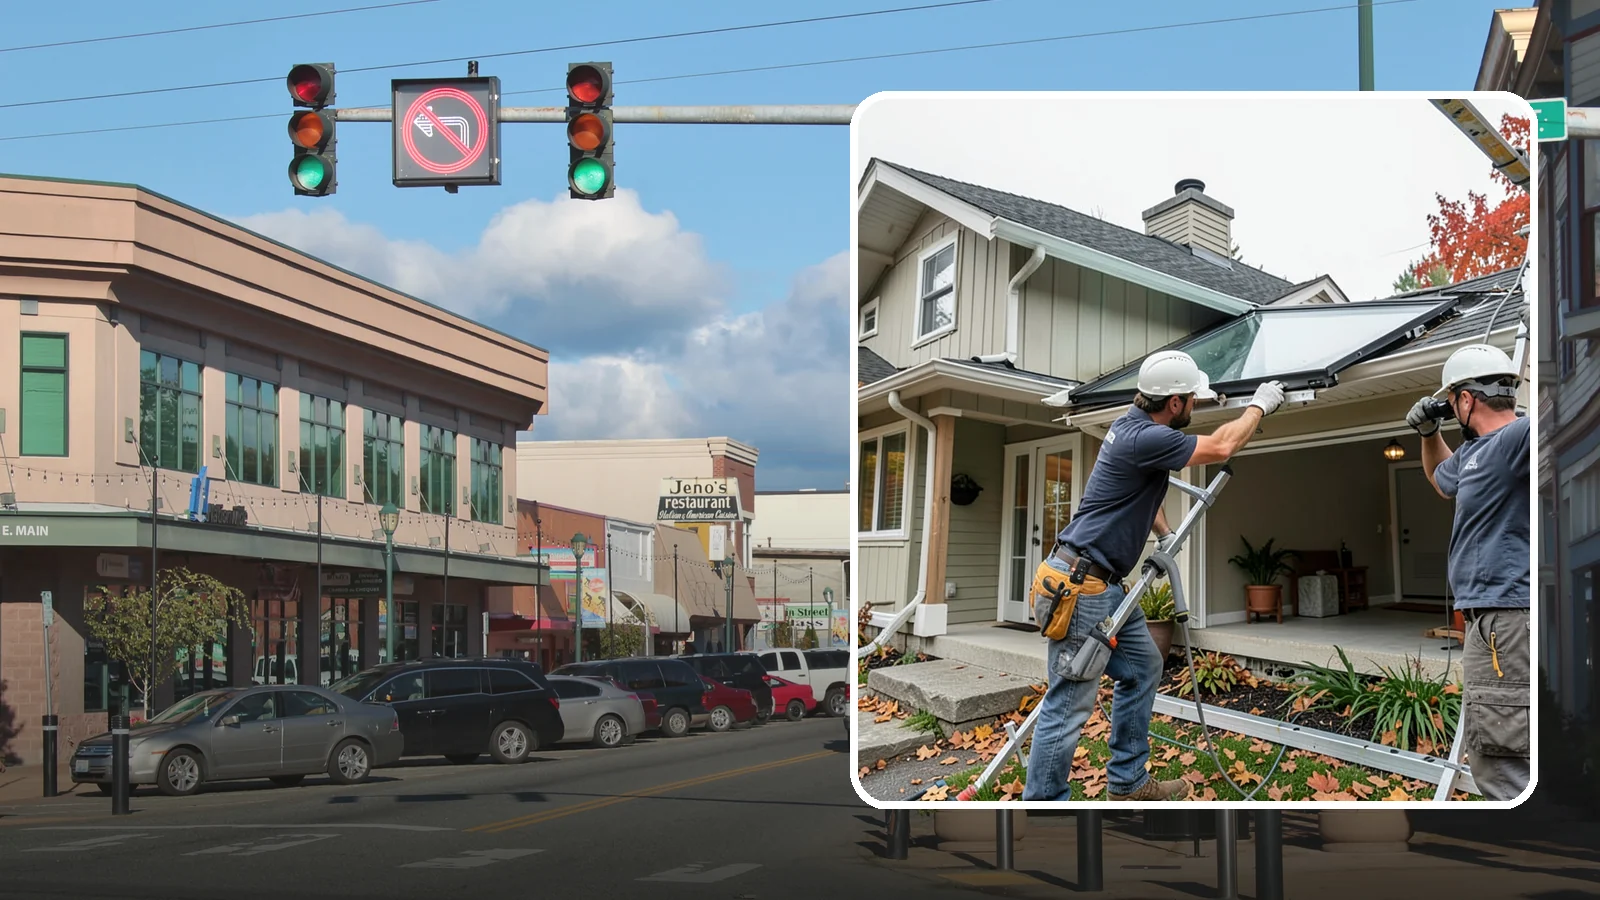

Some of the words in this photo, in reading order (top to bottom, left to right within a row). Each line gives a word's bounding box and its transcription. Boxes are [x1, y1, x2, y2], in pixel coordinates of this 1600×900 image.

[670, 480, 727, 495] Jeno's
[665, 496, 731, 509] restaurant
[658, 510, 681, 519] Italian
[686, 510, 714, 519] American
[715, 510, 737, 519] Cuisine
[2, 525, 13, 536] E.
[15, 525, 49, 536] MAIN
[797, 608, 828, 616] Street
